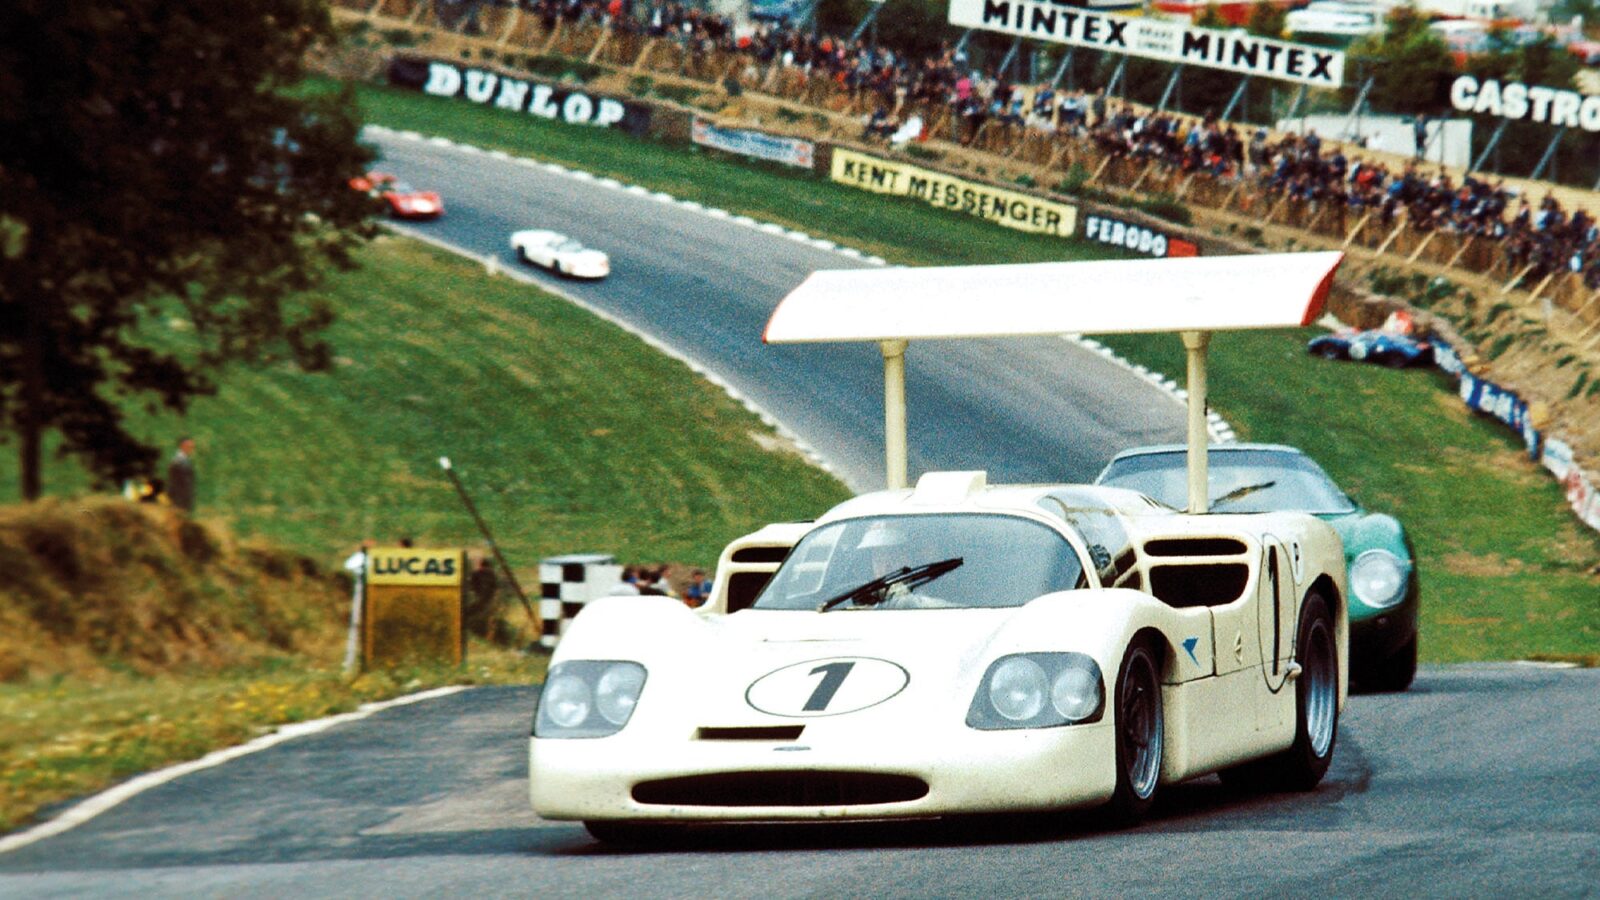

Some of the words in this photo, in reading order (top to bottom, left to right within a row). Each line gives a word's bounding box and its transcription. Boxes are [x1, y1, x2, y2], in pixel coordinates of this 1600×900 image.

[983, 0, 1127, 47] MINTEX
[1182, 31, 1333, 80] MINTEX
[424, 62, 625, 127] DUNLOP
[1451, 75, 1600, 132] CASTRO
[844, 159, 900, 188] KENT
[908, 175, 1061, 229] MESSENGER
[1086, 215, 1167, 257] FERODO
[374, 557, 455, 576] LUCAS
[801, 661, 856, 711] 1
